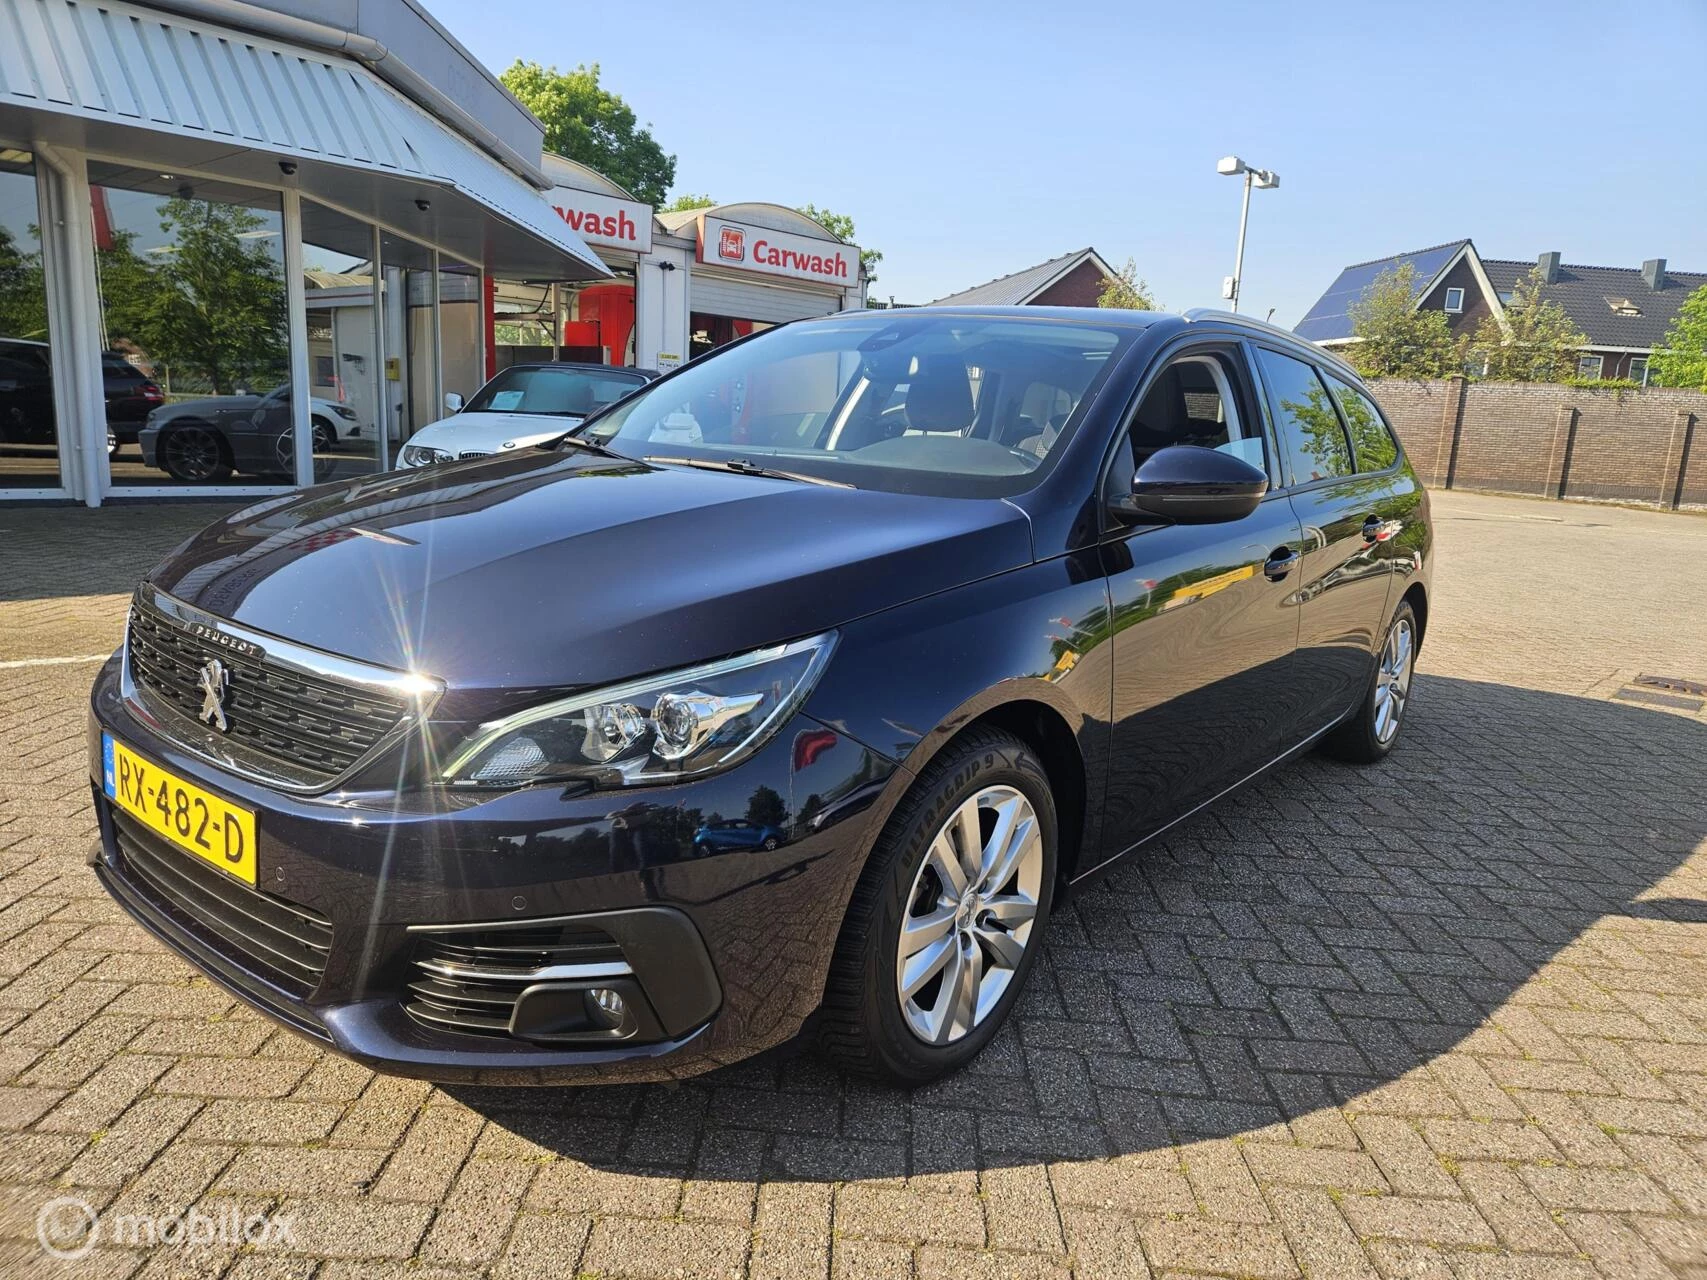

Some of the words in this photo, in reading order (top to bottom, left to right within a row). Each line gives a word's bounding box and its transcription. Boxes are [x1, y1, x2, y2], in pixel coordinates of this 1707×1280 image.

[552, 205, 637, 241] wash
[753, 240, 848, 278] Carwash
[196, 625, 257, 655] PEUGEOT
[105, 770, 115, 790] NL
[119, 753, 244, 863] RX-482-D
[901, 762, 981, 869] ULTRAGRIP
[984, 753, 994, 769] 9
